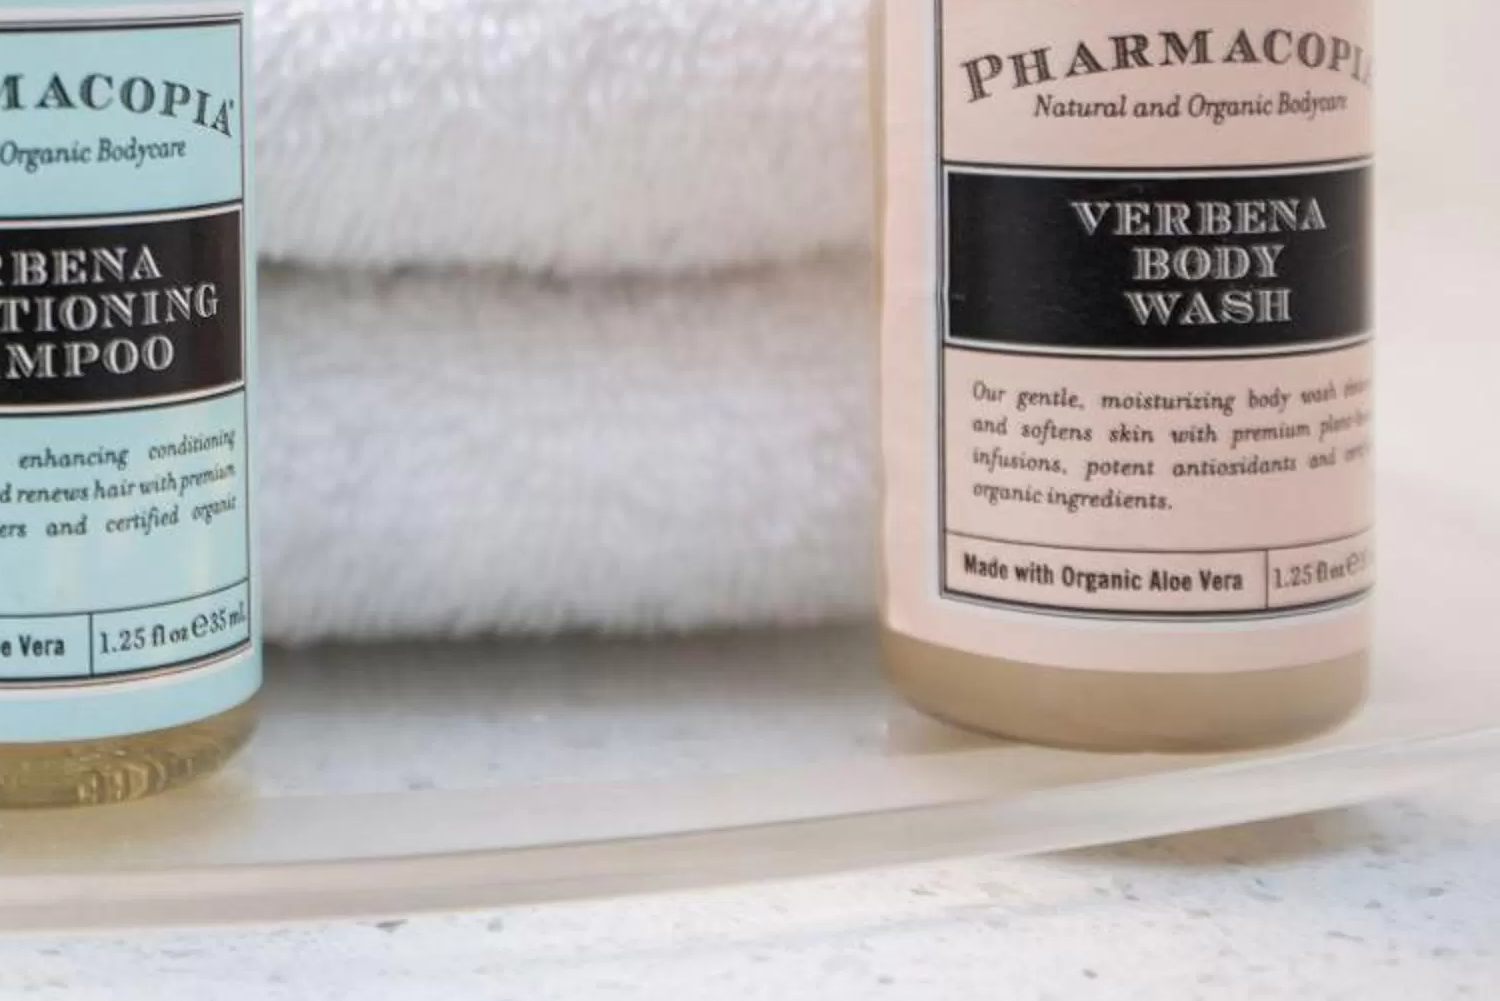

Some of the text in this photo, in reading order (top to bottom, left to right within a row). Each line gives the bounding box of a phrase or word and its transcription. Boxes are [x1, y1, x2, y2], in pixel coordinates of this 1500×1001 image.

[1033, 90, 1348, 126] Natural and Organic Bodycare
[0, 139, 92, 173] Organic
[96, 137, 186, 168] Bodycare
[1071, 197, 1328, 237] VERBENA
[1131, 244, 1286, 281] BODY
[1123, 287, 1293, 326] WASH
[972, 380, 1007, 403] Our
[1015, 387, 1085, 412] gentle,
[1101, 391, 1237, 417] moisturizing
[1248, 387, 1292, 414] body
[18, 447, 129, 471] enhancing
[148, 428, 235, 461] conditioning
[972, 415, 1008, 436] and
[1020, 418, 1093, 446] softens
[1108, 422, 1155, 444] skin
[1170, 422, 1218, 444] with
[1230, 422, 1311, 450] premium
[972, 446, 1068, 474] infusions,
[1084, 458, 1155, 481] potent
[1172, 455, 1297, 478] antioxidants
[1308, 446, 1337, 470] and
[16, 486, 88, 504] renews
[93, 478, 136, 500] hair
[139, 472, 177, 496] with
[179, 463, 235, 497] premium
[972, 482, 1173, 513] organic ingredients.
[45, 512, 88, 537] and
[105, 503, 180, 536] certified
[963, 552, 1243, 594] Made with Organic Aloe Vera
[1273, 562, 1312, 589] 1.25
[18, 633, 66, 658] Vera
[100, 626, 146, 655] 1.25
[151, 622, 166, 647] fl
[169, 626, 190, 644] oz
